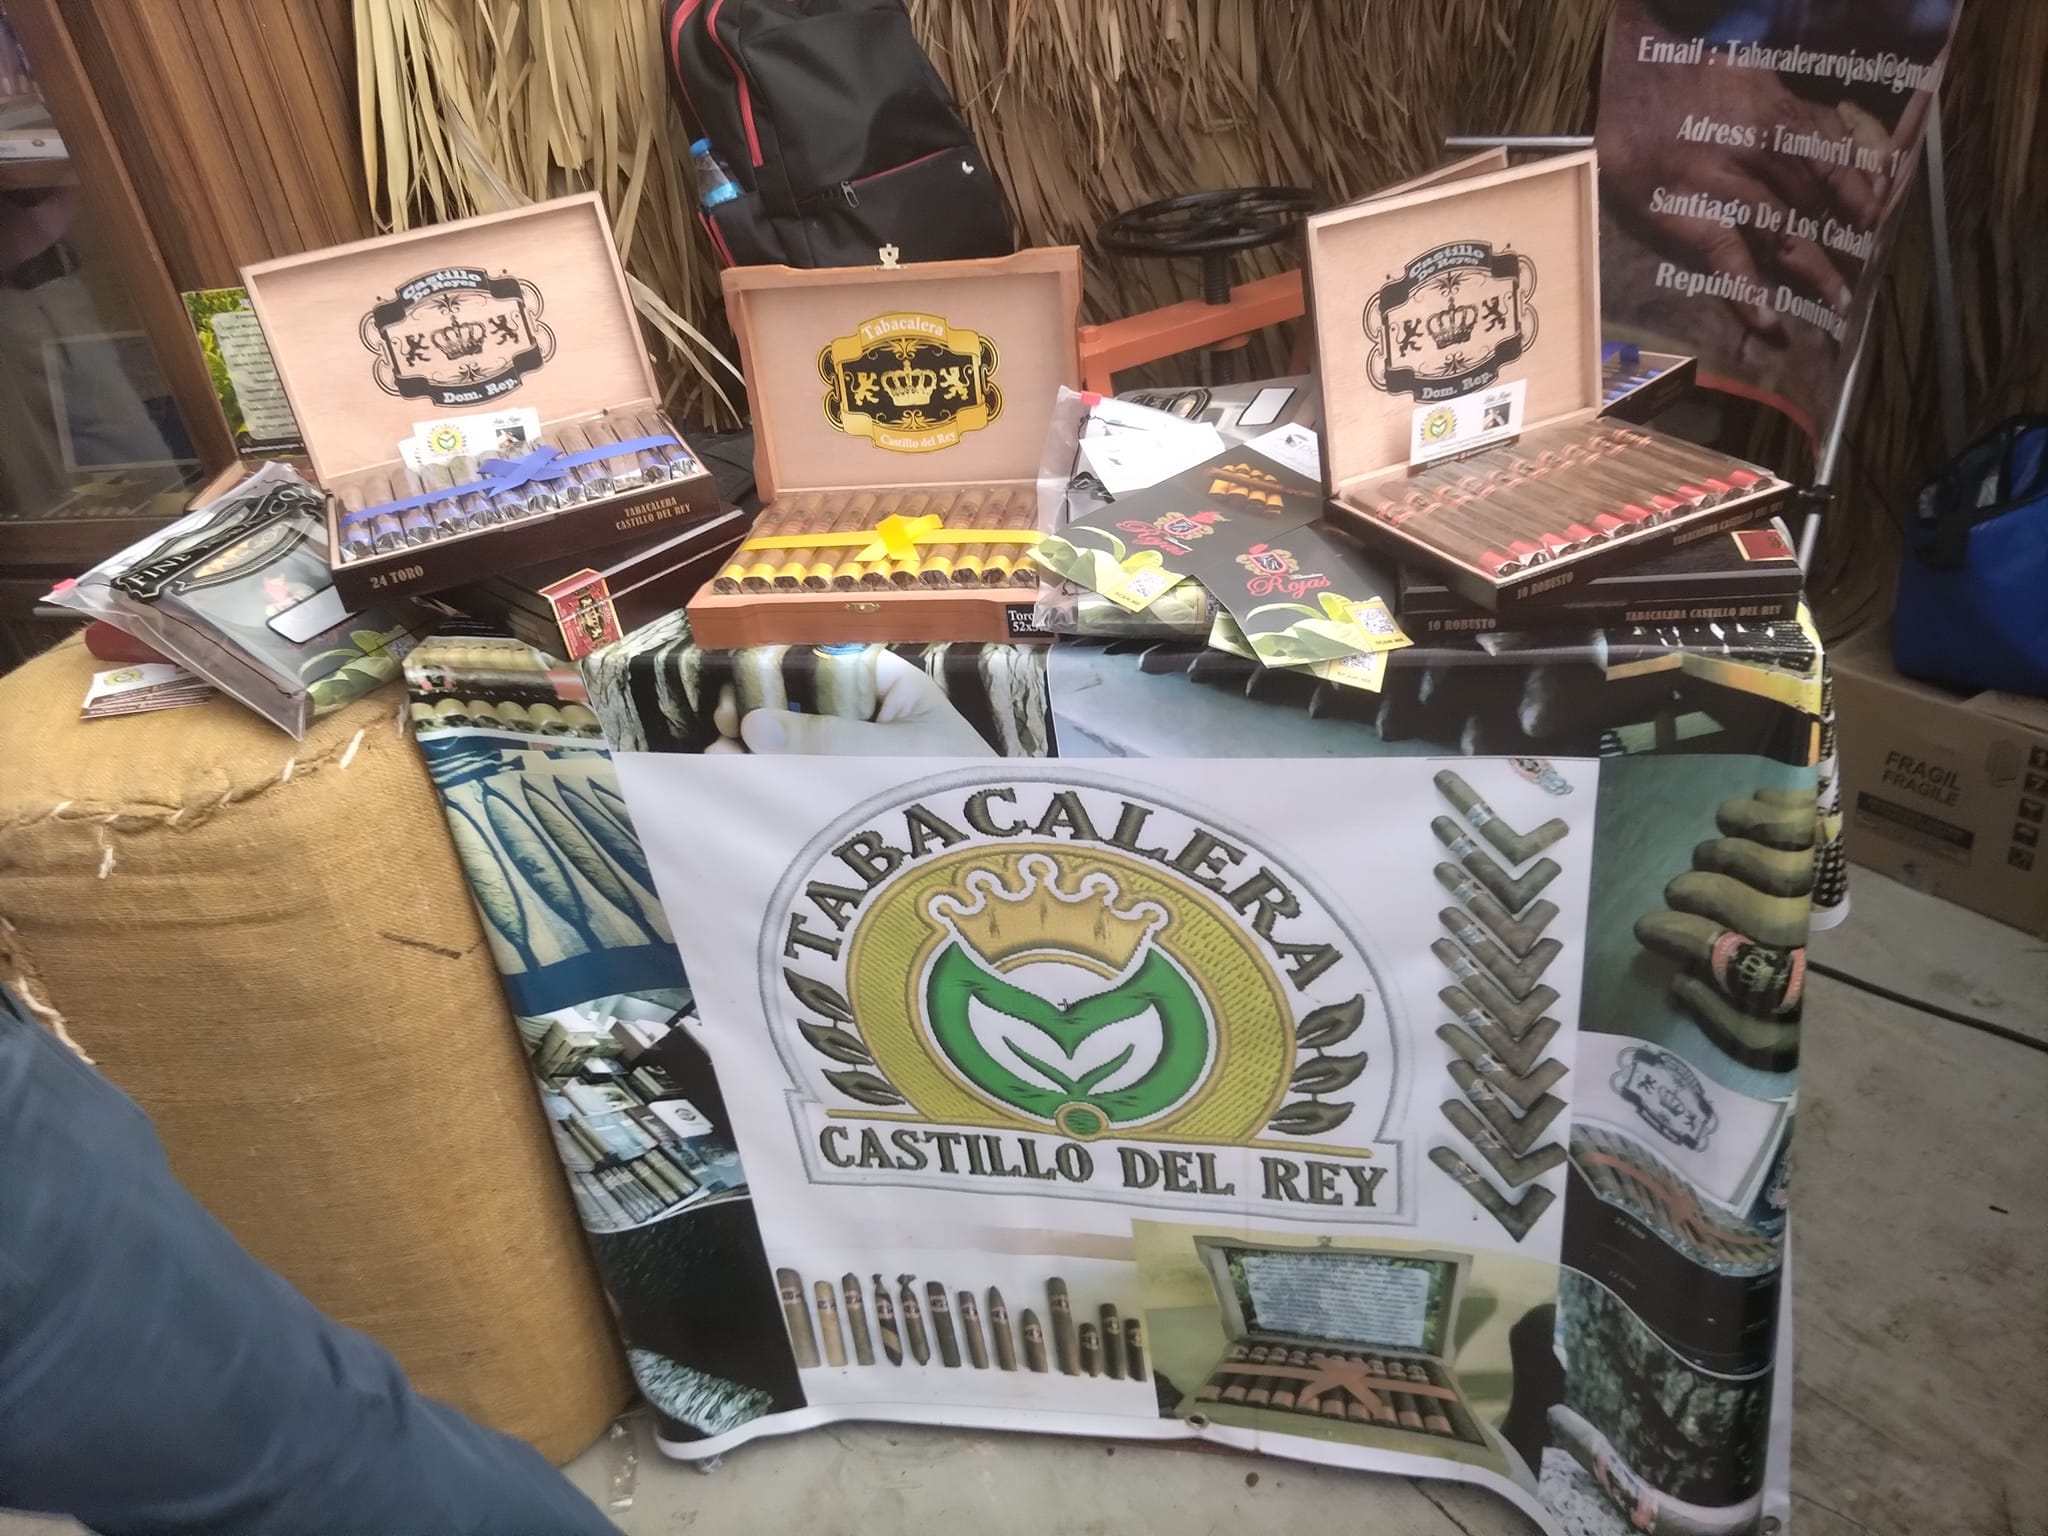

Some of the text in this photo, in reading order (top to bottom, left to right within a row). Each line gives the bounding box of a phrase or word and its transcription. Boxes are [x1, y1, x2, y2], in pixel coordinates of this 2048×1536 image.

[1638, 35, 1704, 65] Email
[1676, 114, 1757, 148] Adress
[1773, 124, 1853, 167] Tamboril
[1855, 146, 1883, 174] no.
[1649, 186, 1751, 229] Santiago
[1755, 203, 1782, 233] De
[1785, 207, 1819, 241] Los
[402, 270, 482, 300] Castillo
[1655, 261, 1769, 307] República
[861, 316, 945, 341] Tabacalera
[443, 376, 518, 404] Dom. Rep.
[1422, 371, 1494, 400] Dom. Rep.
[880, 431, 956, 449] Castillo del Rey
[615, 503, 692, 531] CASTILLO DEL REY
[623, 496, 678, 518] TABACALERA
[128, 551, 193, 587] FINE
[369, 564, 425, 590] 24 TORO
[1531, 571, 1575, 596] ROBUSTO
[1246, 572, 1332, 599] Rojas
[1427, 618, 1497, 632] 10 ROBUSTO
[1625, 604, 1783, 622] TABACALERA CASTILLO DEL REY
[1884, 750, 1961, 791] FRAGIL
[1881, 769, 1960, 807] FRAGILE
[783, 786, 1345, 992] TABACALERA
[819, 1125, 1389, 1208] CASTILLO DEL REY
